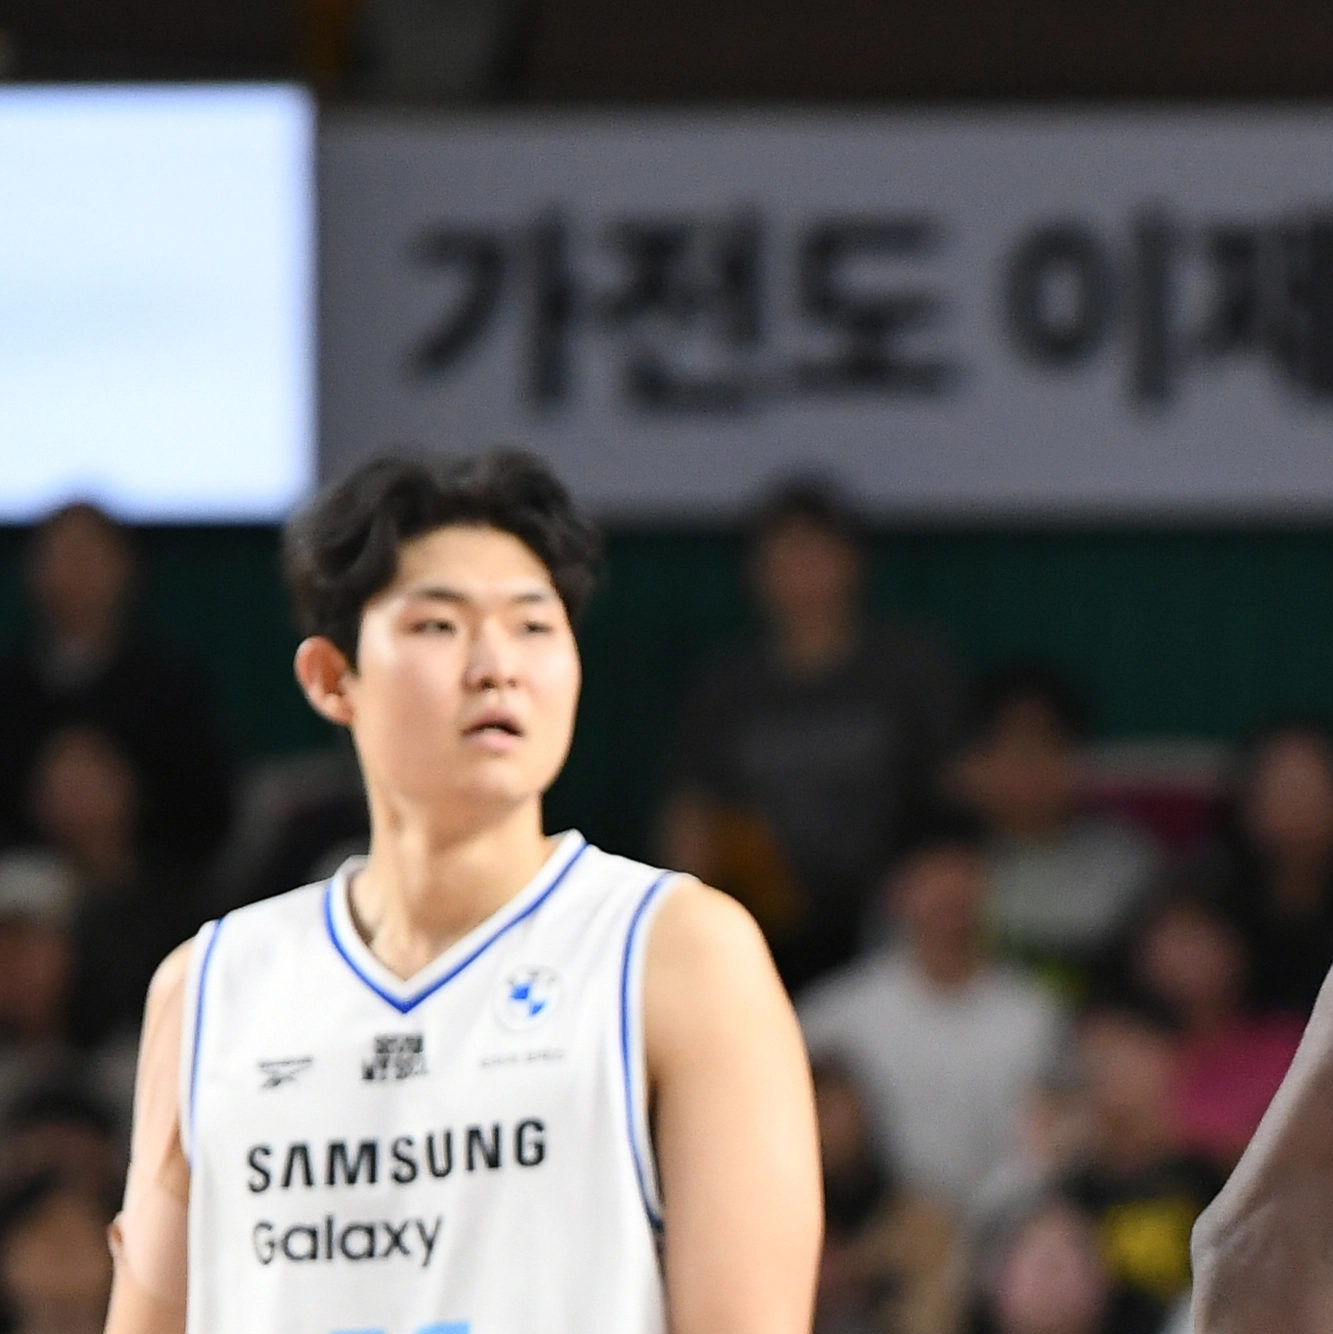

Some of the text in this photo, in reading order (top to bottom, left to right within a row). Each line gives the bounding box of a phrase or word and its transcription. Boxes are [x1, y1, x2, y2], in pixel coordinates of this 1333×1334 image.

[408, 203, 960, 418] 가전도
[247, 1119, 548, 1194] SAMSUNG
[254, 1216, 443, 1267] Galaxy
